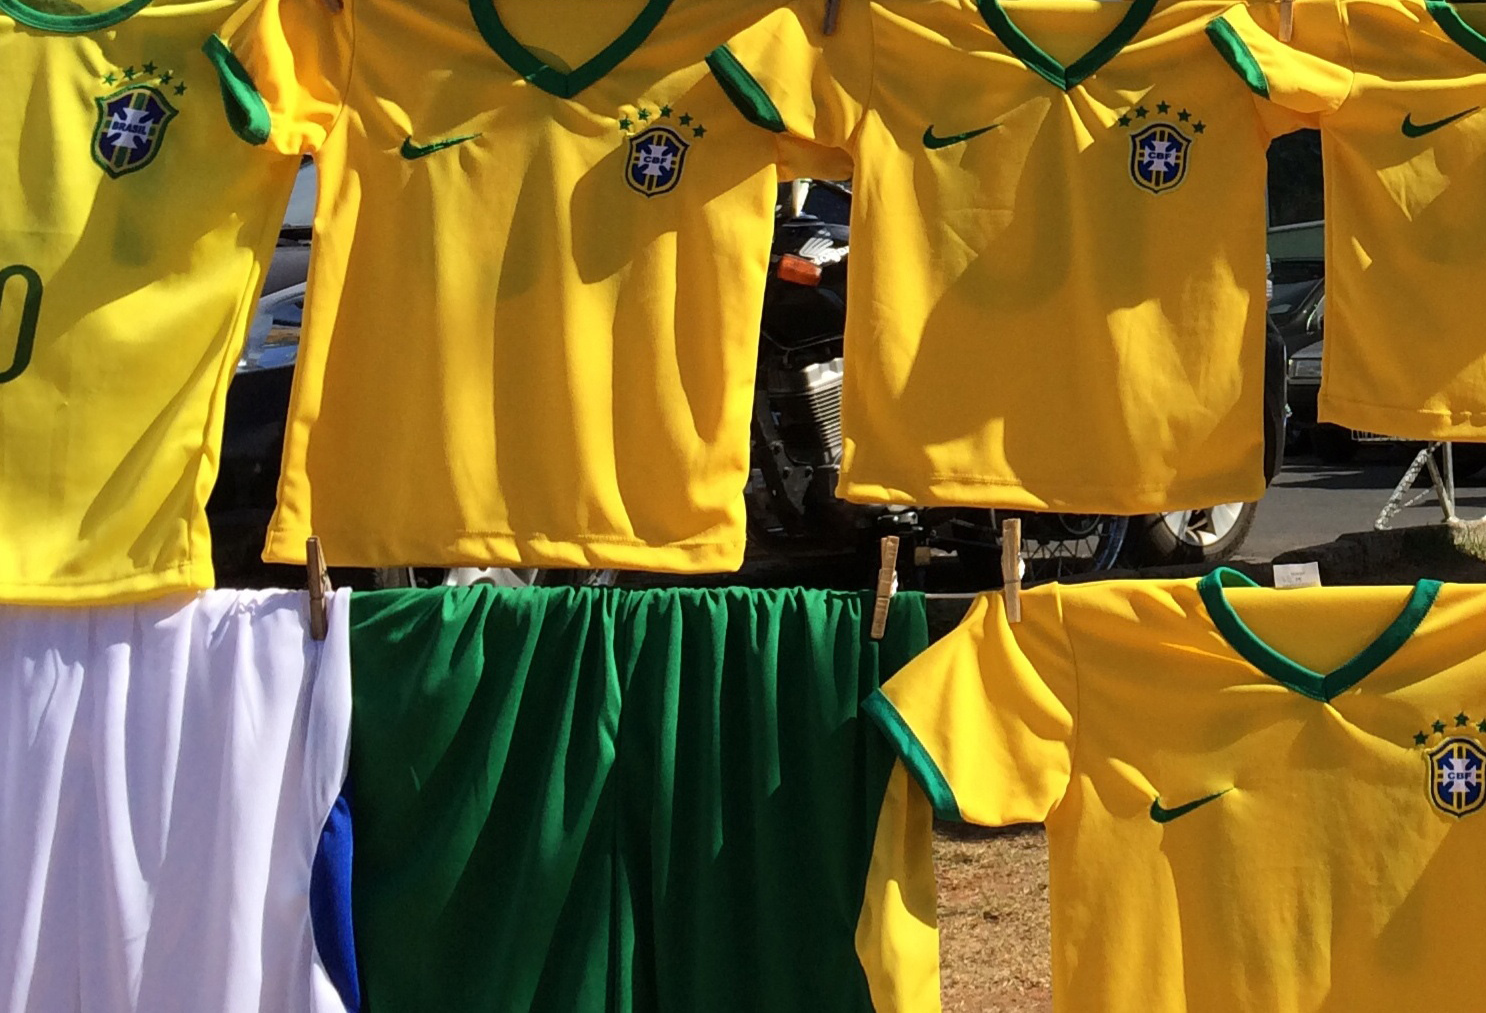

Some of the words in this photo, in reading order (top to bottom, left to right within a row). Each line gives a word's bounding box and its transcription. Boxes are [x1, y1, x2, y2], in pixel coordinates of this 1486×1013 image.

[111, 119, 147, 137] BRASIL
[1148, 151, 1172, 160] CBF
[643, 156, 668, 165] CBF
[1448, 771, 1472, 780] CBF
